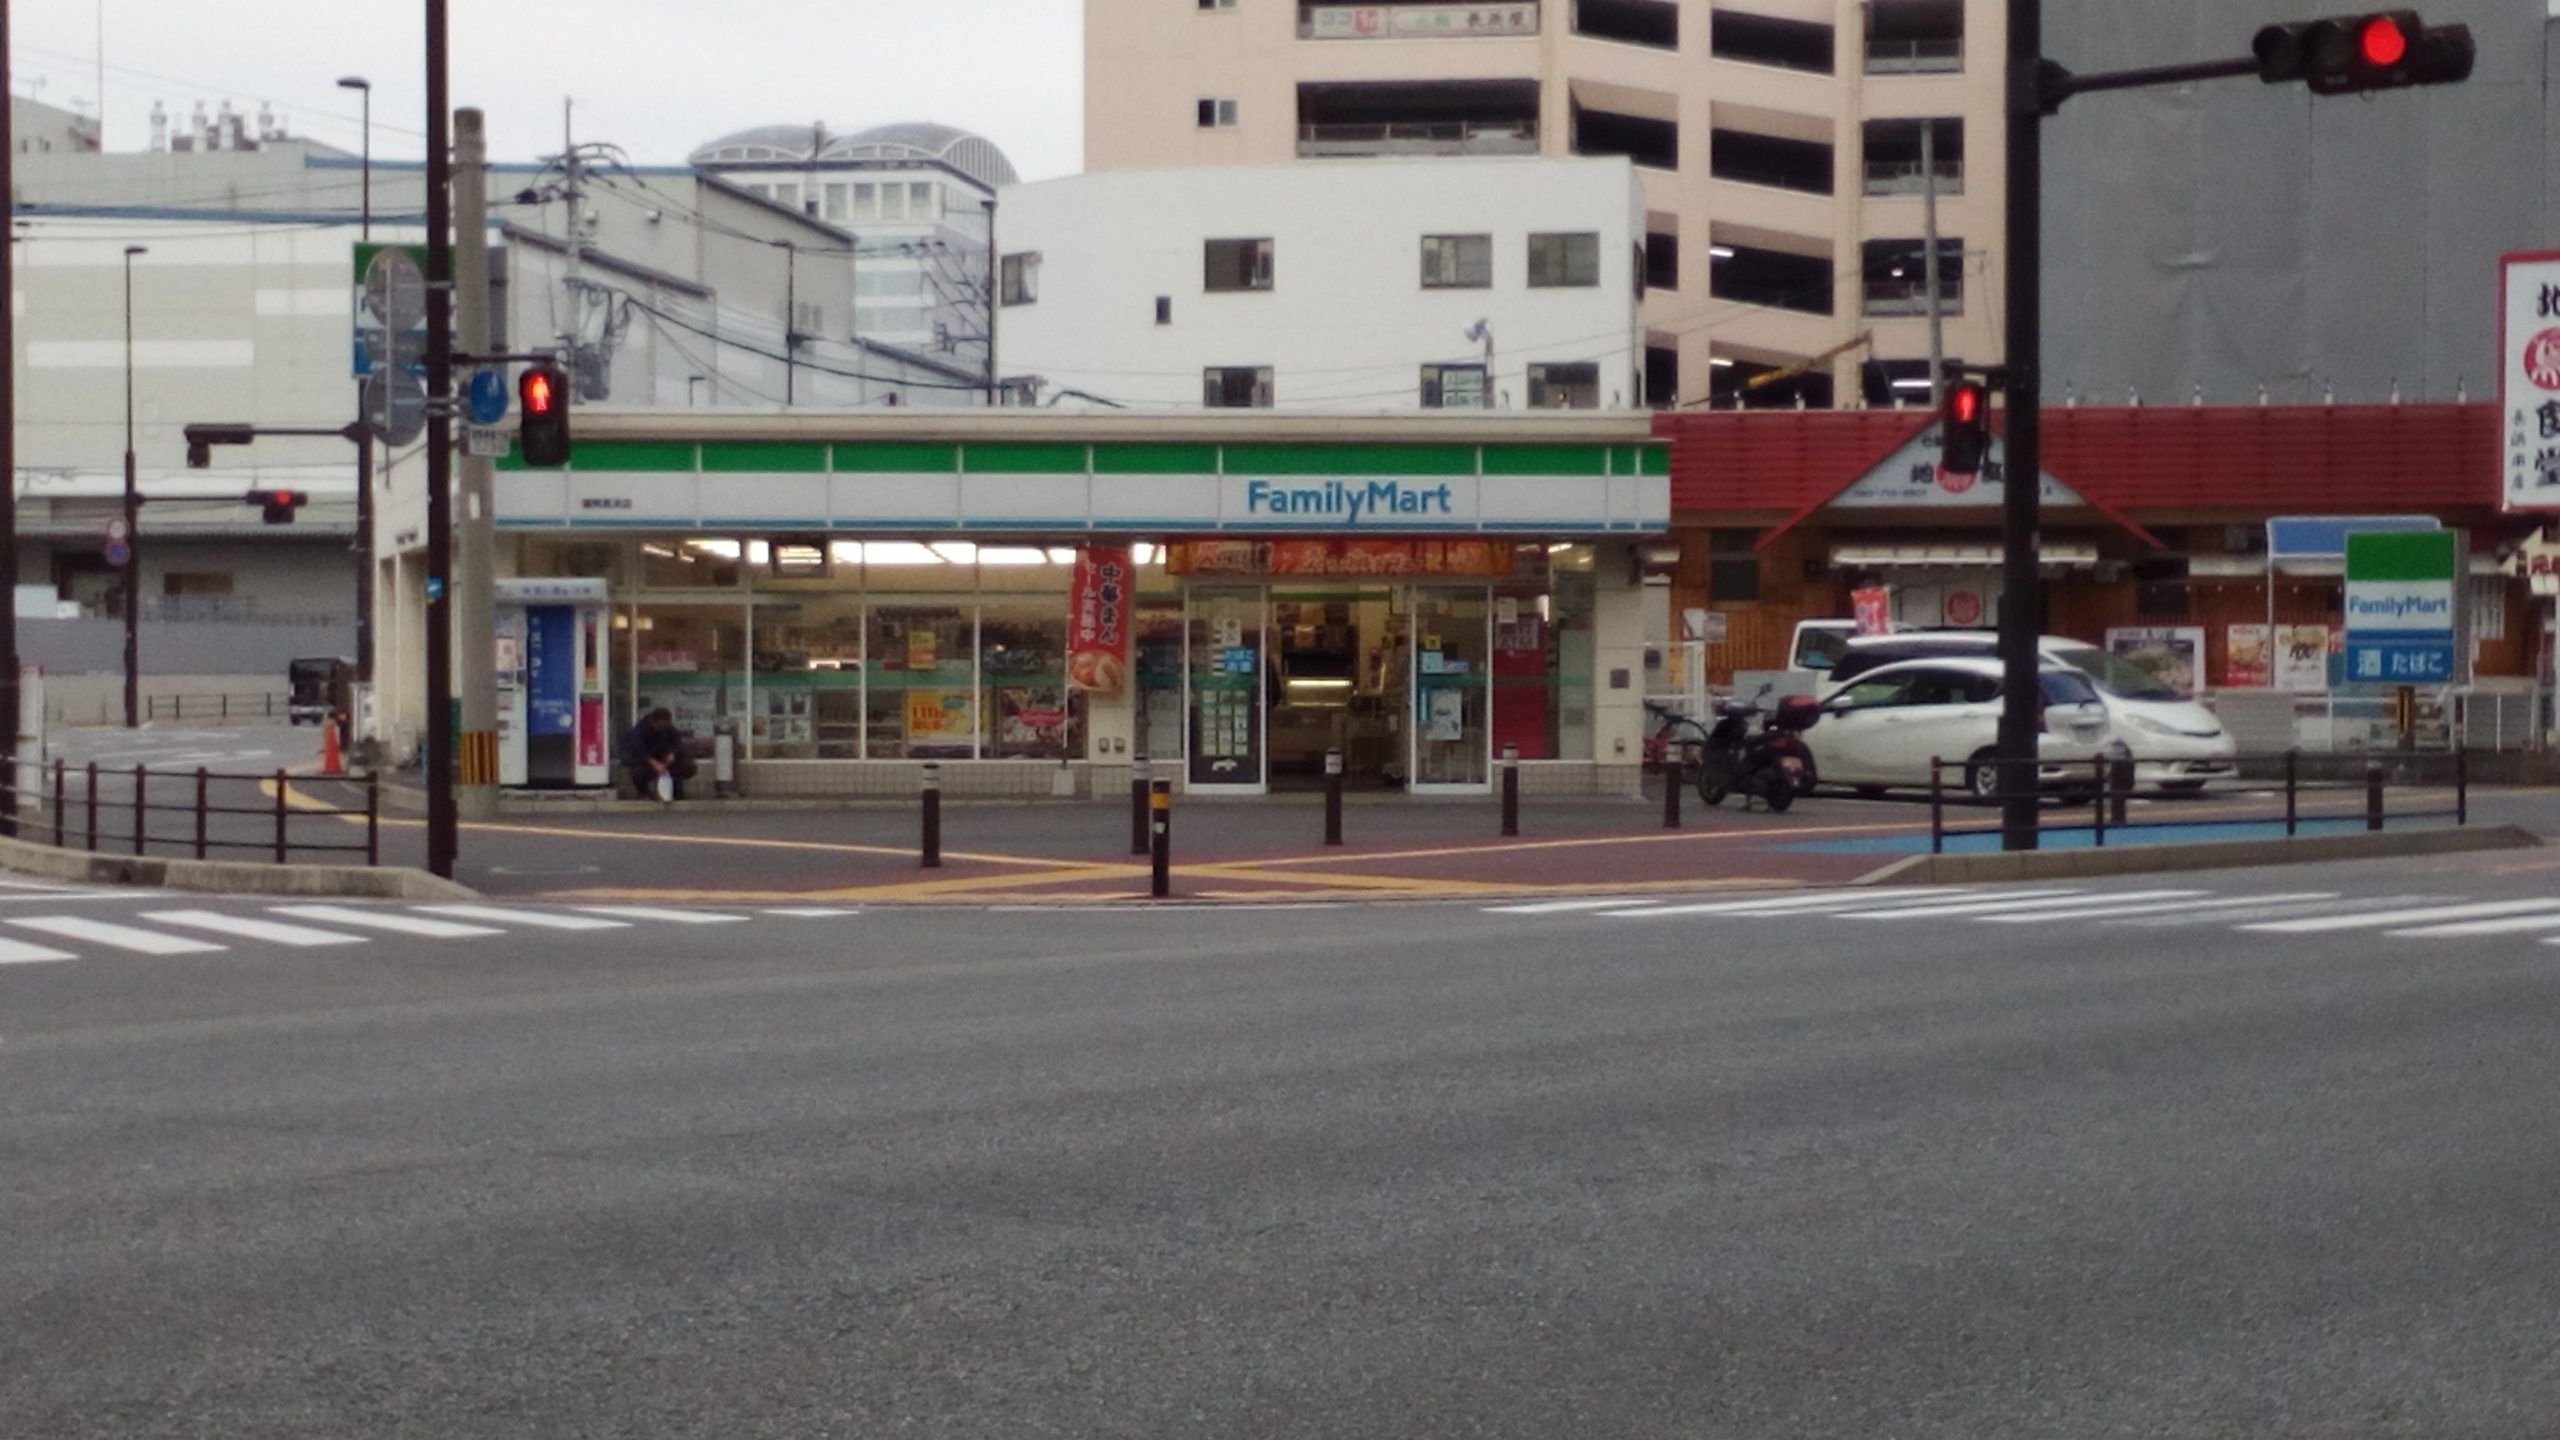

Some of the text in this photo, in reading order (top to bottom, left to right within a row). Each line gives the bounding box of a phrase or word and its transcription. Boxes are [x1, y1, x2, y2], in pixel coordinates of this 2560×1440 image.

[1248, 480, 1452, 524] FamilyMart
[1101, 562, 1122, 646] 中華まん
[2350, 596, 2448, 618] FamilyMart
[2392, 652, 2443, 675] たばこ
